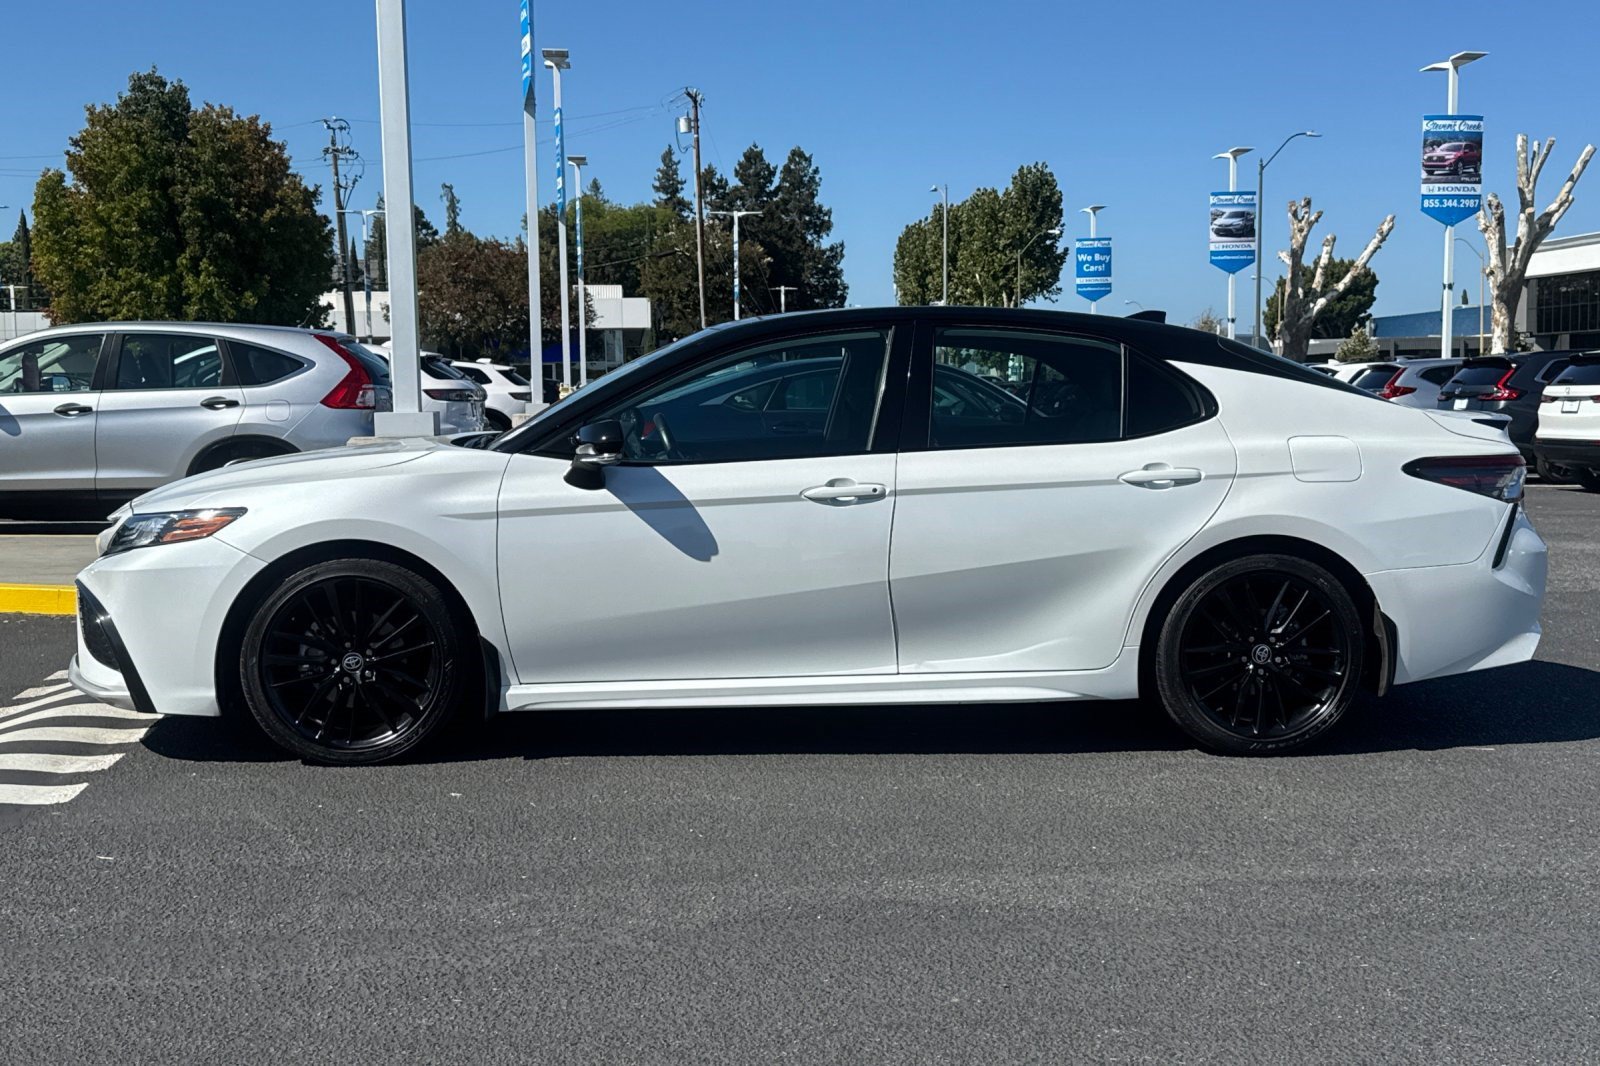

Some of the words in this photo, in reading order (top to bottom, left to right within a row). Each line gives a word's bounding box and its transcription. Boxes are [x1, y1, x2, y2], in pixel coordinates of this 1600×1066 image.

[1458, 120, 1481, 131] Creek
[1423, 199, 1479, 208] 855.344.2987
[1077, 253, 1093, 262] We
[1094, 253, 1111, 263] Buy
[1083, 263, 1105, 272] Cars!
